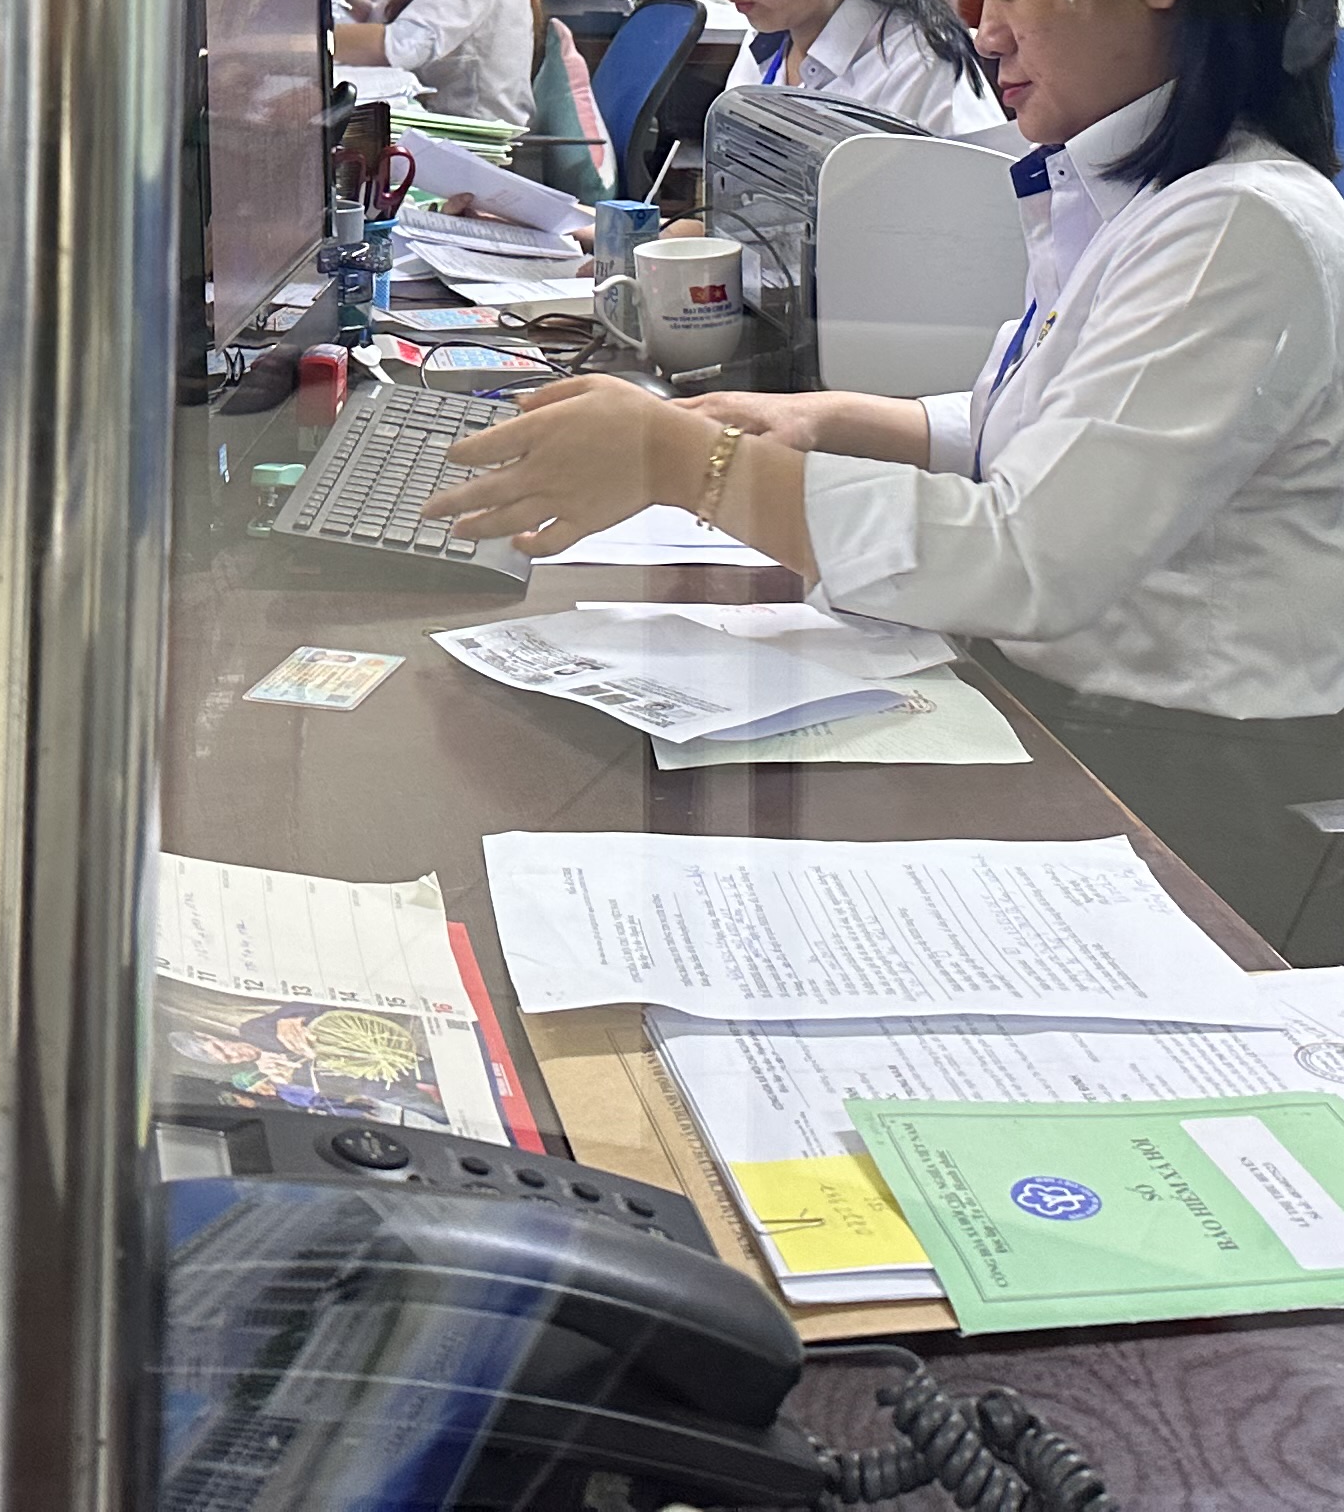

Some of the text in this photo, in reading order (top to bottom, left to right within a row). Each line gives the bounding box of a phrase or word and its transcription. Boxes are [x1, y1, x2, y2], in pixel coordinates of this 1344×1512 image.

[197, 969, 217, 984] 11
[244, 978, 265, 992] 12
[291, 984, 313, 998] 13
[338, 990, 359, 1003] 14
[385, 996, 407, 1009] 15
[432, 999, 454, 1015] 16
